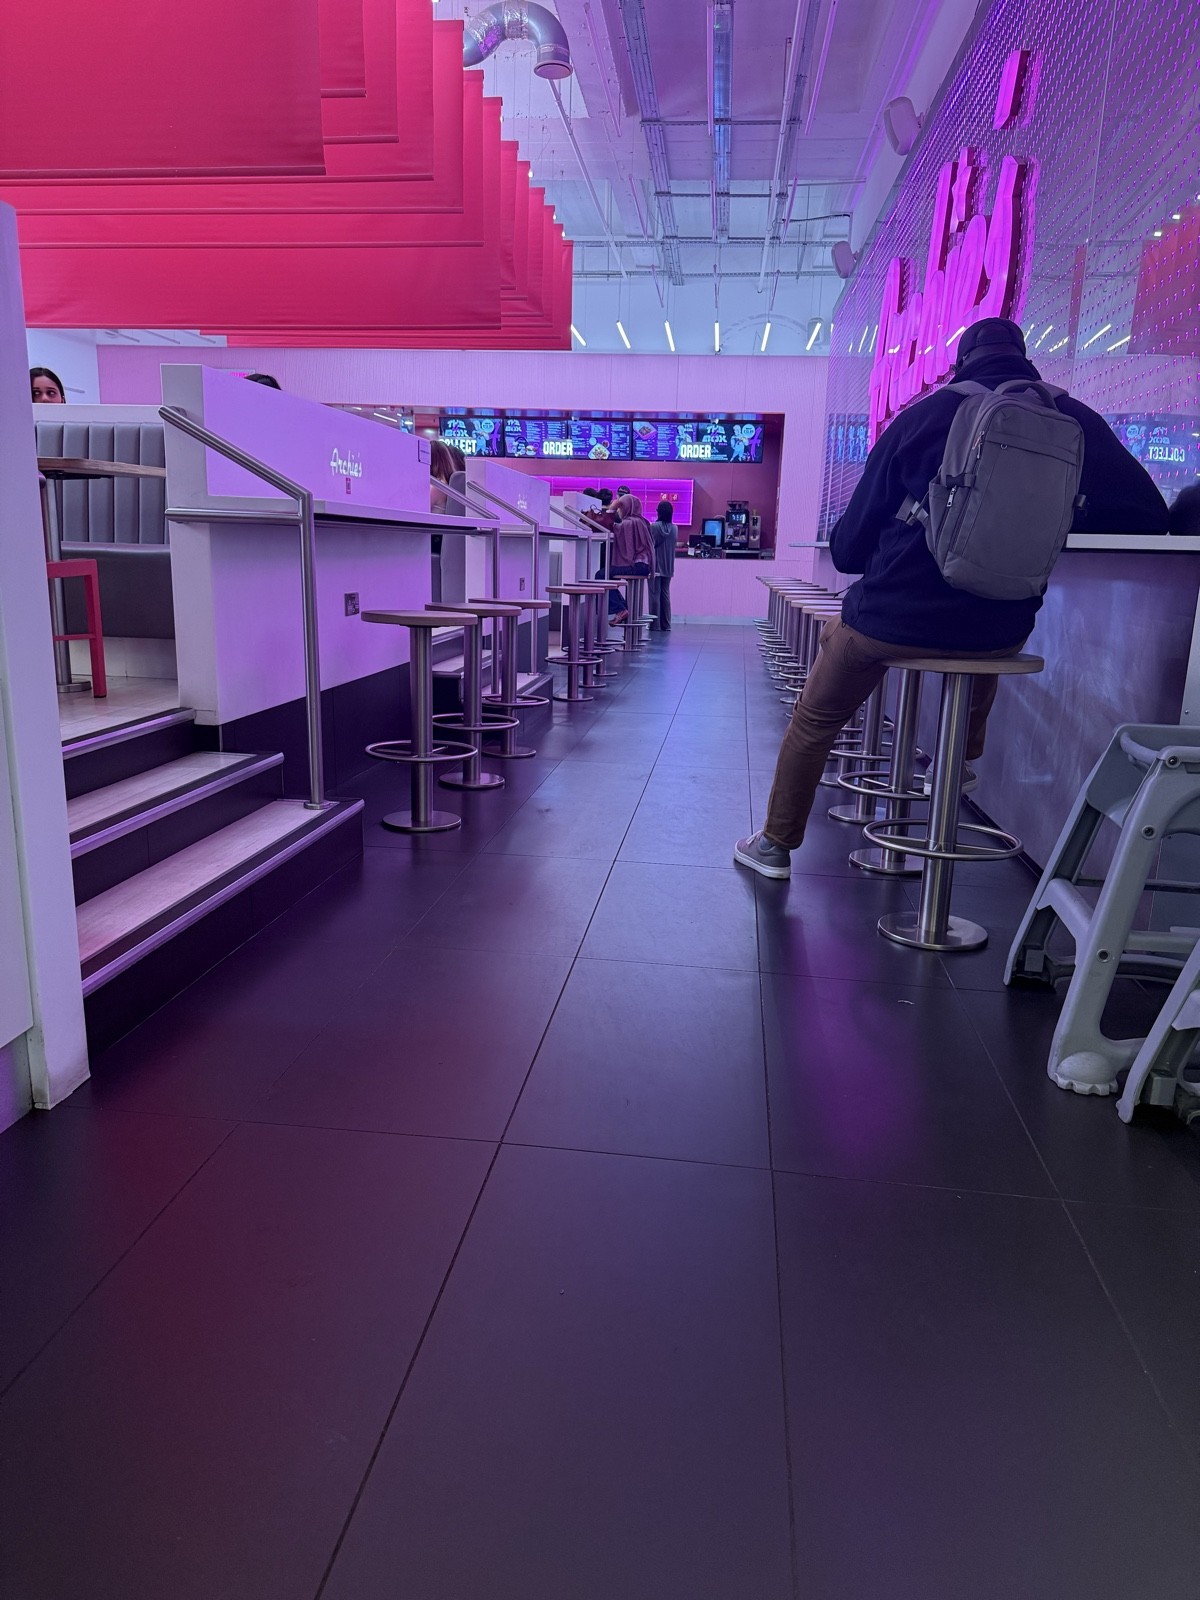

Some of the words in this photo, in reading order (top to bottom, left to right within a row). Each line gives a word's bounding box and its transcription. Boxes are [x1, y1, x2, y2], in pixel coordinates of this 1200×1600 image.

[543, 441, 573, 456] ORDER
[680, 443, 712, 459] ORDER
[330, 447, 363, 478] Archie's
